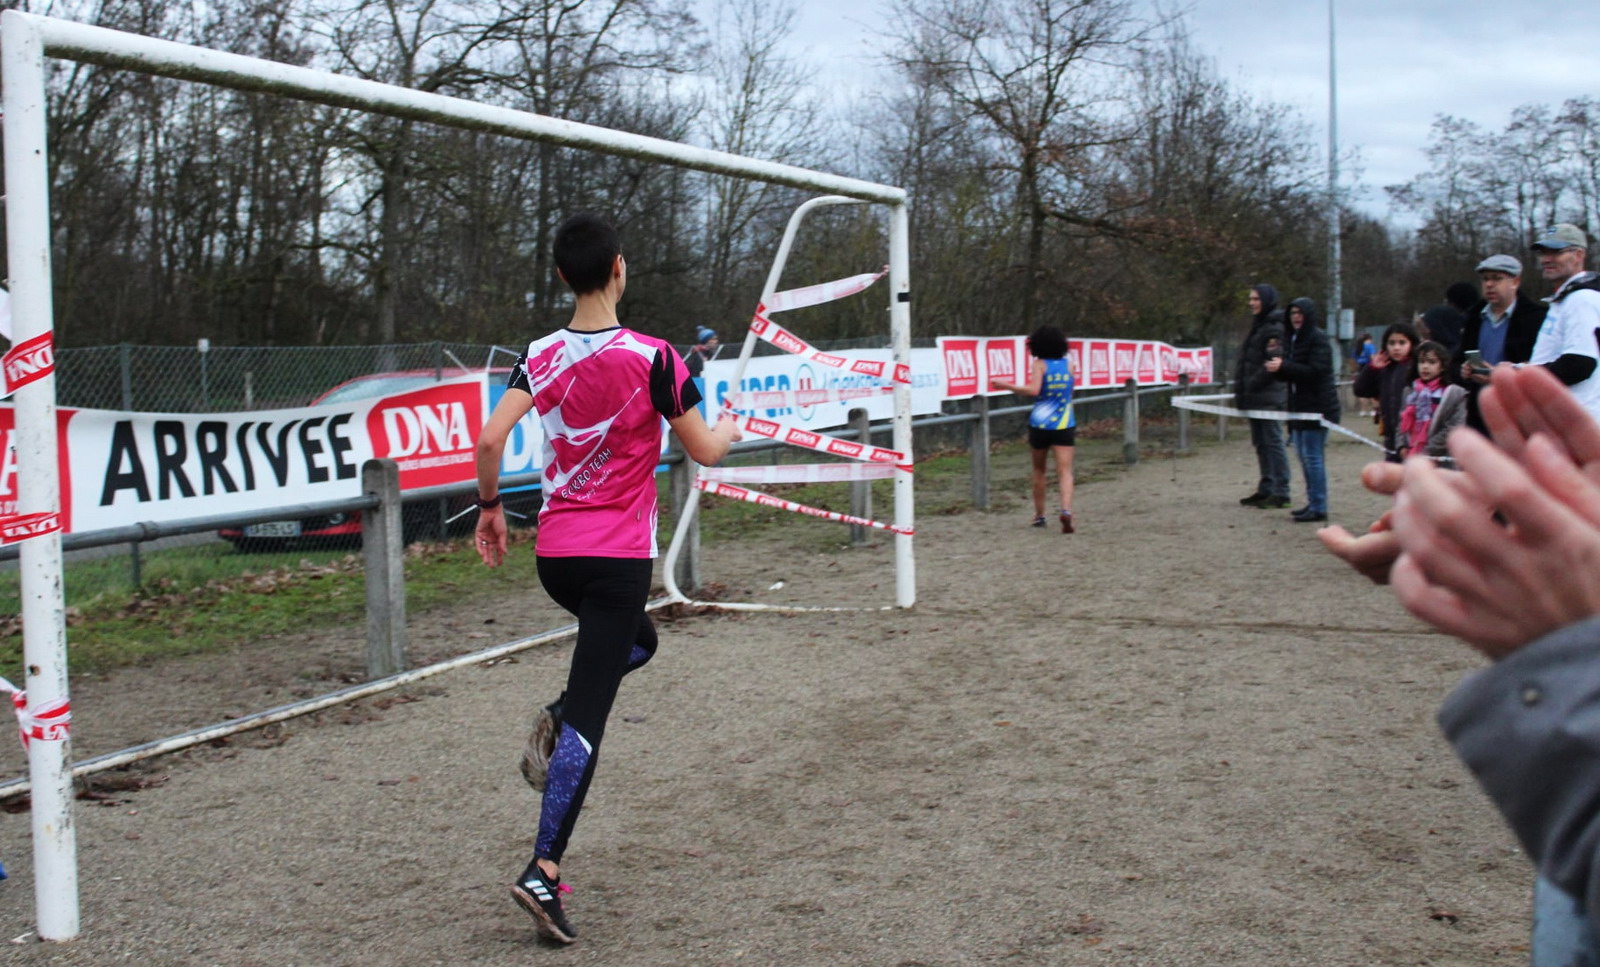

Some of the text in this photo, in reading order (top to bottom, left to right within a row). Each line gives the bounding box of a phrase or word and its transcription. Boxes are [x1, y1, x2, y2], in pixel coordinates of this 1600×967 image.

[777, 333, 802, 352] DNA
[856, 361, 881, 374] DNA
[946, 349, 976, 378] DNA
[988, 348, 1014, 375] DNA
[381, 401, 474, 458] DNA
[749, 420, 776, 436] DNA
[789, 430, 816, 444] DNA
[100, 413, 357, 506] ARRIVEE
[561, 448, 613, 499] ECKBO TEAM
